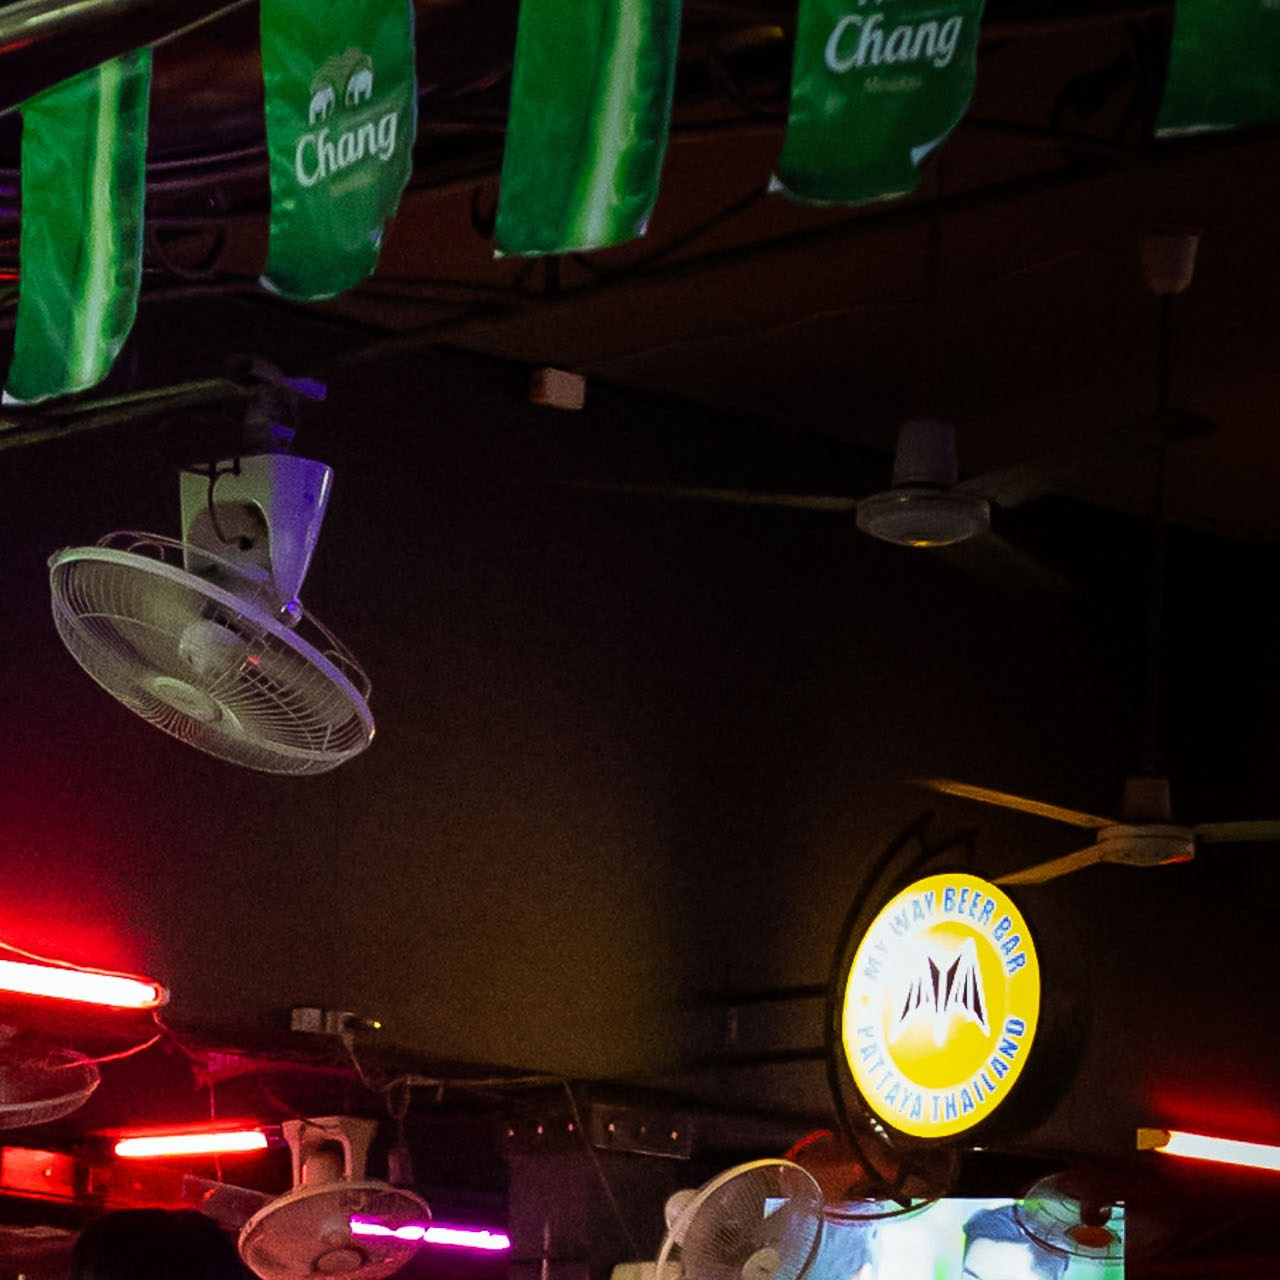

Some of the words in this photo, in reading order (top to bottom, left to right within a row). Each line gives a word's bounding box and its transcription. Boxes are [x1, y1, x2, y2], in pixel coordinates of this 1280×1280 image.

[824, 13, 963, 73] Chang
[295, 112, 398, 187] Chang
[889, 892, 935, 936] WAY
[943, 887, 995, 926] BEER
[994, 916, 1027, 974] BAR
[857, 1025, 924, 1120] PATTAYA
[932, 1018, 1026, 1122] THAILAND
